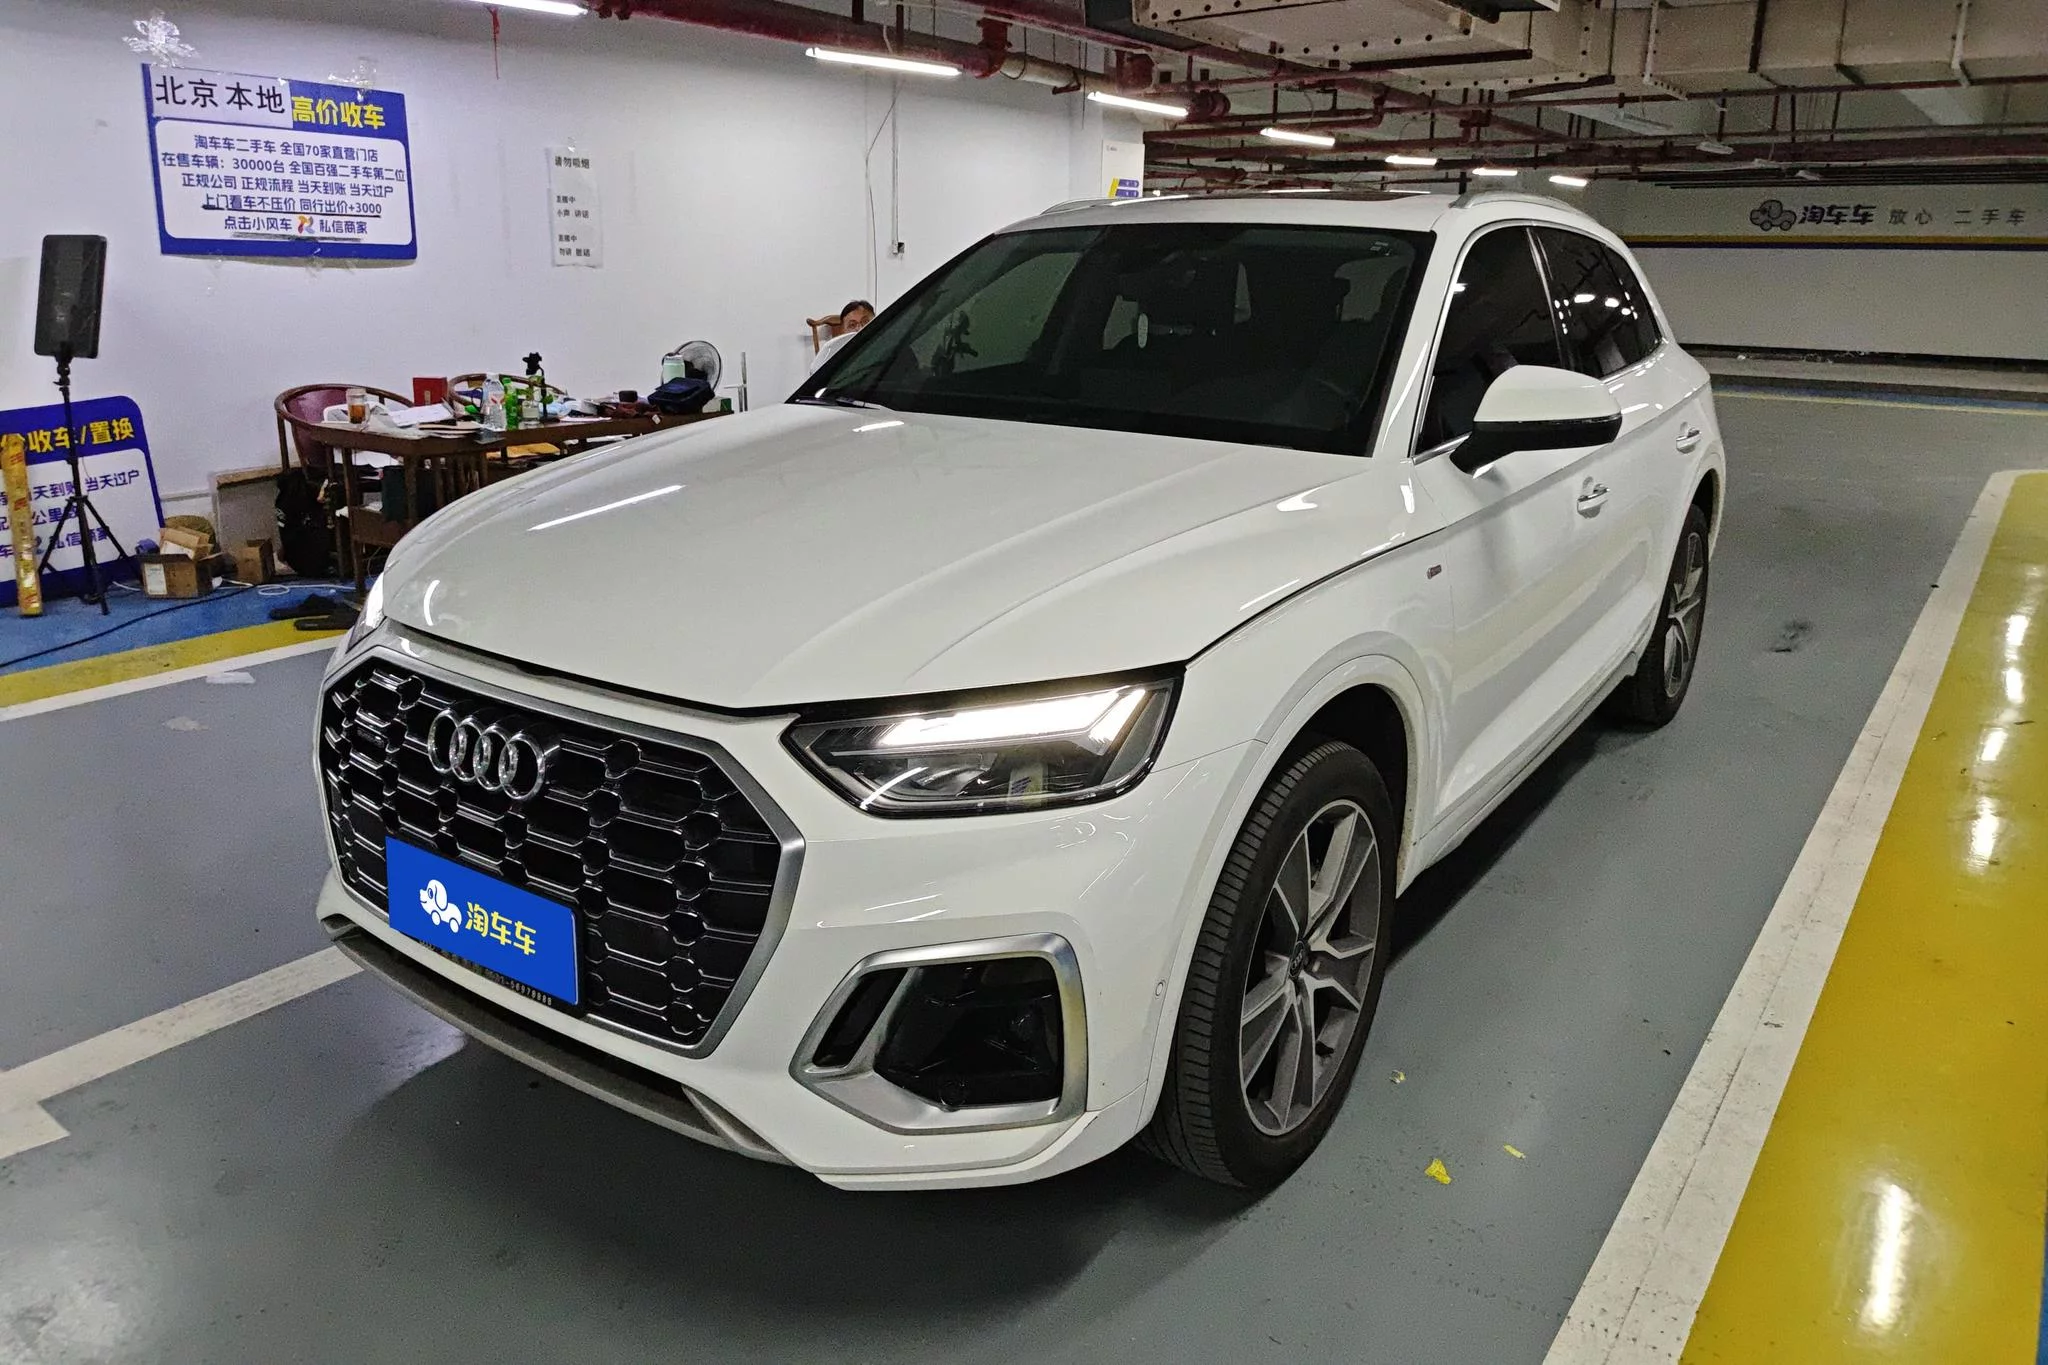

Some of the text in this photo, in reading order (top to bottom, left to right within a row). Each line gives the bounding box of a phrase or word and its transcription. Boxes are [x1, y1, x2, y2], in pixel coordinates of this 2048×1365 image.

[155, 74, 386, 130] 北京本地 高价收车
[194, 135, 378, 162] 淘车车二手车 全国70家直营门店
[289, 161, 405, 182] 全国百强二手车第二位
[182, 173, 393, 198] 正规公司 正规流程 当天到账 当天过户
[204, 193, 382, 214] 上门看车不压价 同行出价+3000
[224, 215, 367, 235] 点击小风车 私信商家
[1798, 204, 2026, 226] 淘车车 放心 二手车
[85, 470, 140, 492] 当天过户
[465, 901, 536, 955] 淘车车
